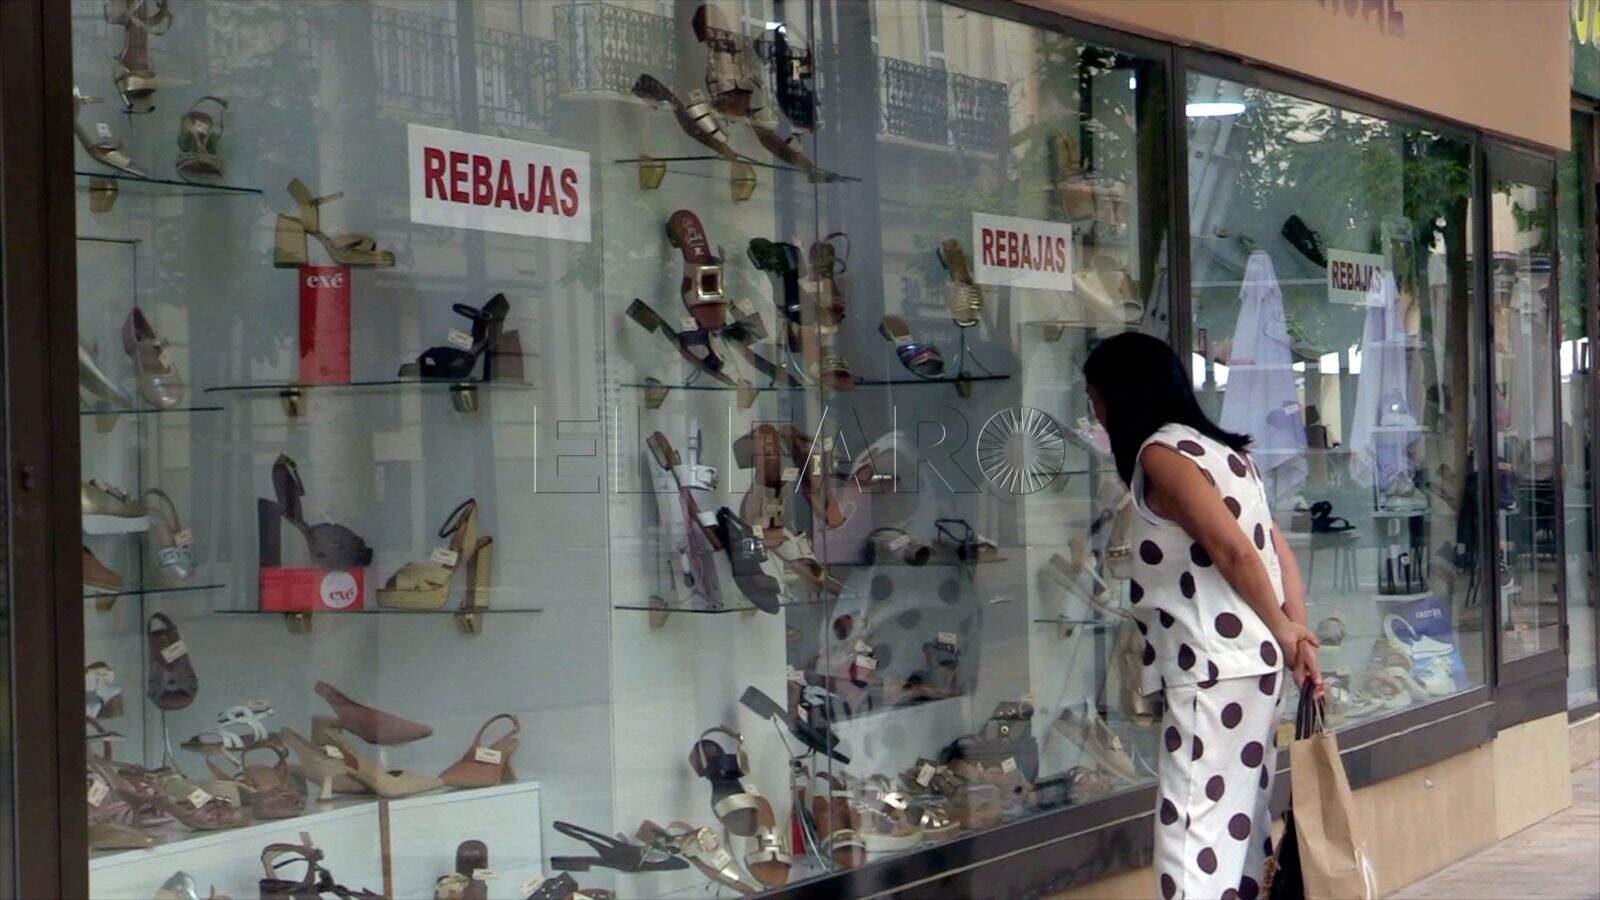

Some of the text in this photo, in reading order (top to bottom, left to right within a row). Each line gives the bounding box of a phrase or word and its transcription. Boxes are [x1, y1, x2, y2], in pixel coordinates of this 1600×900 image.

[423, 146, 580, 218] REBAJAS
[982, 228, 1066, 274] REBAJAS
[306, 272, 344, 288] exé
